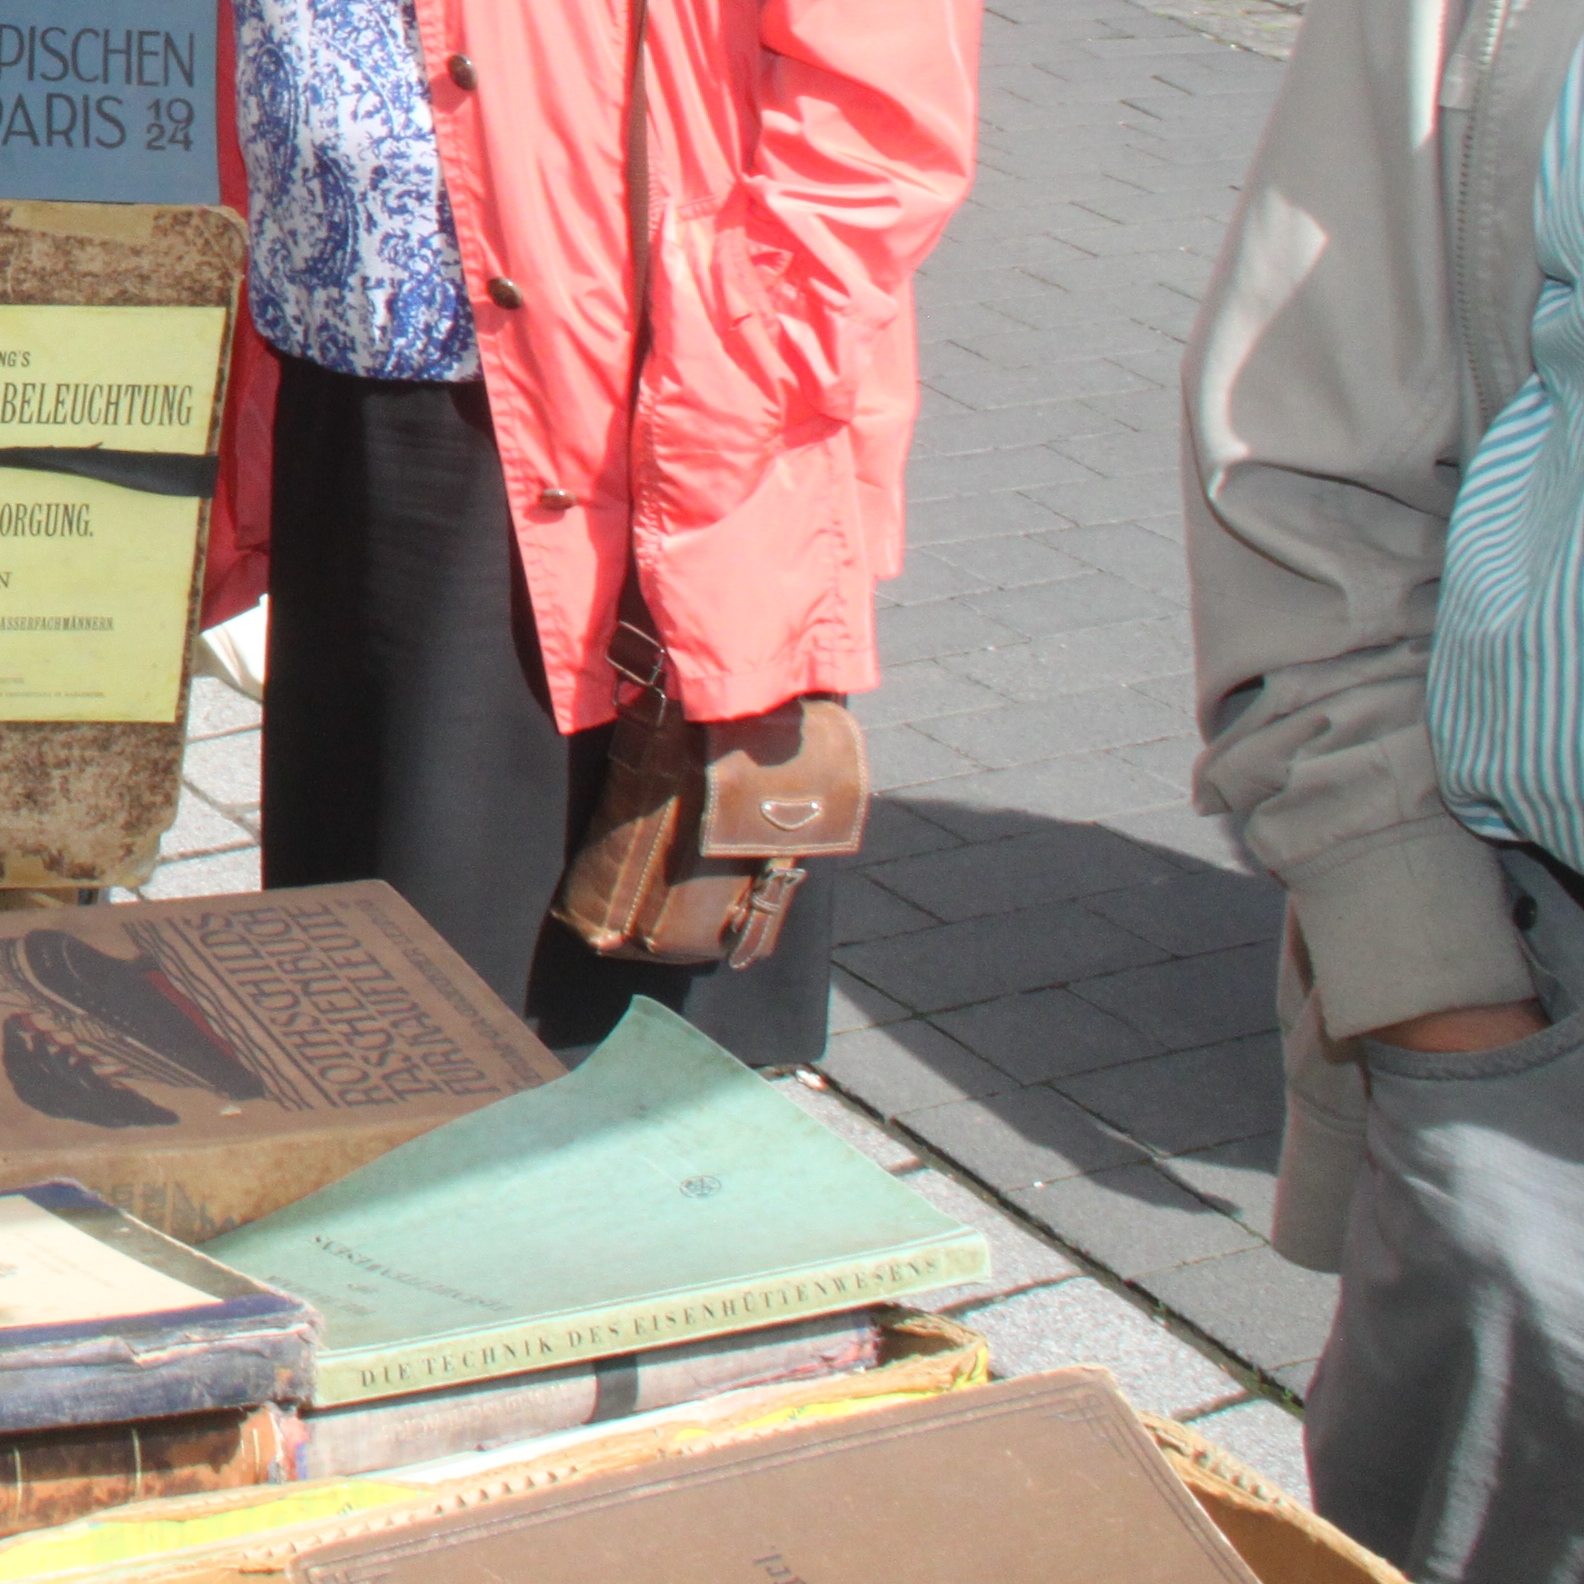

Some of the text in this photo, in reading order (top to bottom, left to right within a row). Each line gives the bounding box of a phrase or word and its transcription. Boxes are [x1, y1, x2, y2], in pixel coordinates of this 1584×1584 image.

[180, 909, 393, 1107] ROTHSCHILDS
[229, 904, 445, 1100] TASCHENBUCH
[280, 899, 455, 1049] KAUFLEUTE
[359, 1254, 944, 1389] DIE TECHNIK DES EISENHÜTTENWESENS
